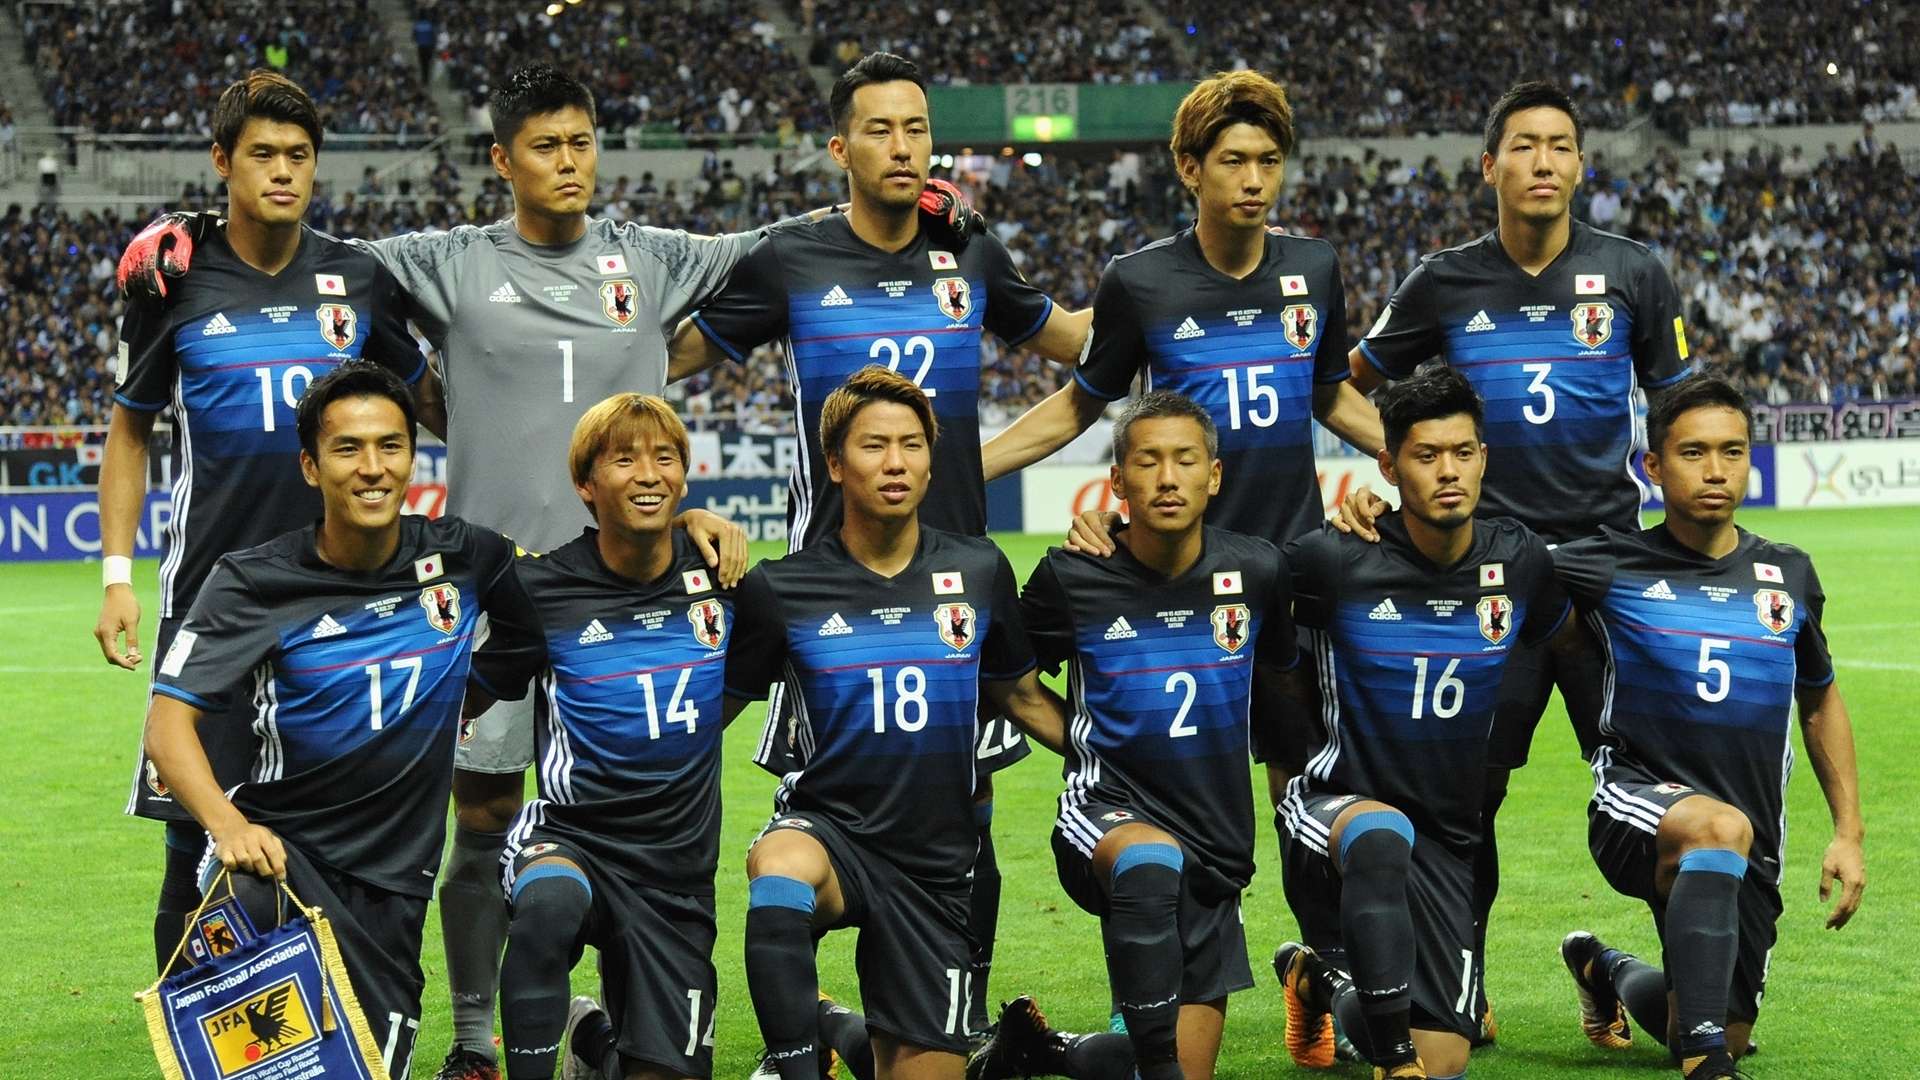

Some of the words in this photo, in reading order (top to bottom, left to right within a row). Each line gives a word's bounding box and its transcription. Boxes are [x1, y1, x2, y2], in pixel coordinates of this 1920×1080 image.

[1015, 88, 1069, 114] 216
[203, 325, 237, 336] adidas
[821, 298, 853, 306] adidas
[1465, 323, 1496, 332] adidas
[1174, 329, 1205, 339] adidas
[557, 340, 573, 402] 1
[870, 336, 936, 397] 22
[1524, 364, 1555, 424] 3
[1223, 366, 1279, 430] 15
[0, 504, 48, 552] N
[579, 632, 614, 644] adidas
[818, 626, 854, 636] adidas
[1104, 630, 1138, 640] adidas
[366, 657, 422, 730] 17
[868, 667, 928, 733] 18
[1413, 658, 1465, 719] 16
[1697, 638, 1731, 703] 5
[637, 668, 699, 740] 14
[1166, 672, 1197, 738] 2
[176, 990, 205, 1010] Japan
[204, 970, 249, 997] Football
[249, 942, 307, 978] Association
[211, 1012, 245, 1037] JFA
[383, 1011, 420, 1080] 17
[277, 1059, 291, 1069] Cup
